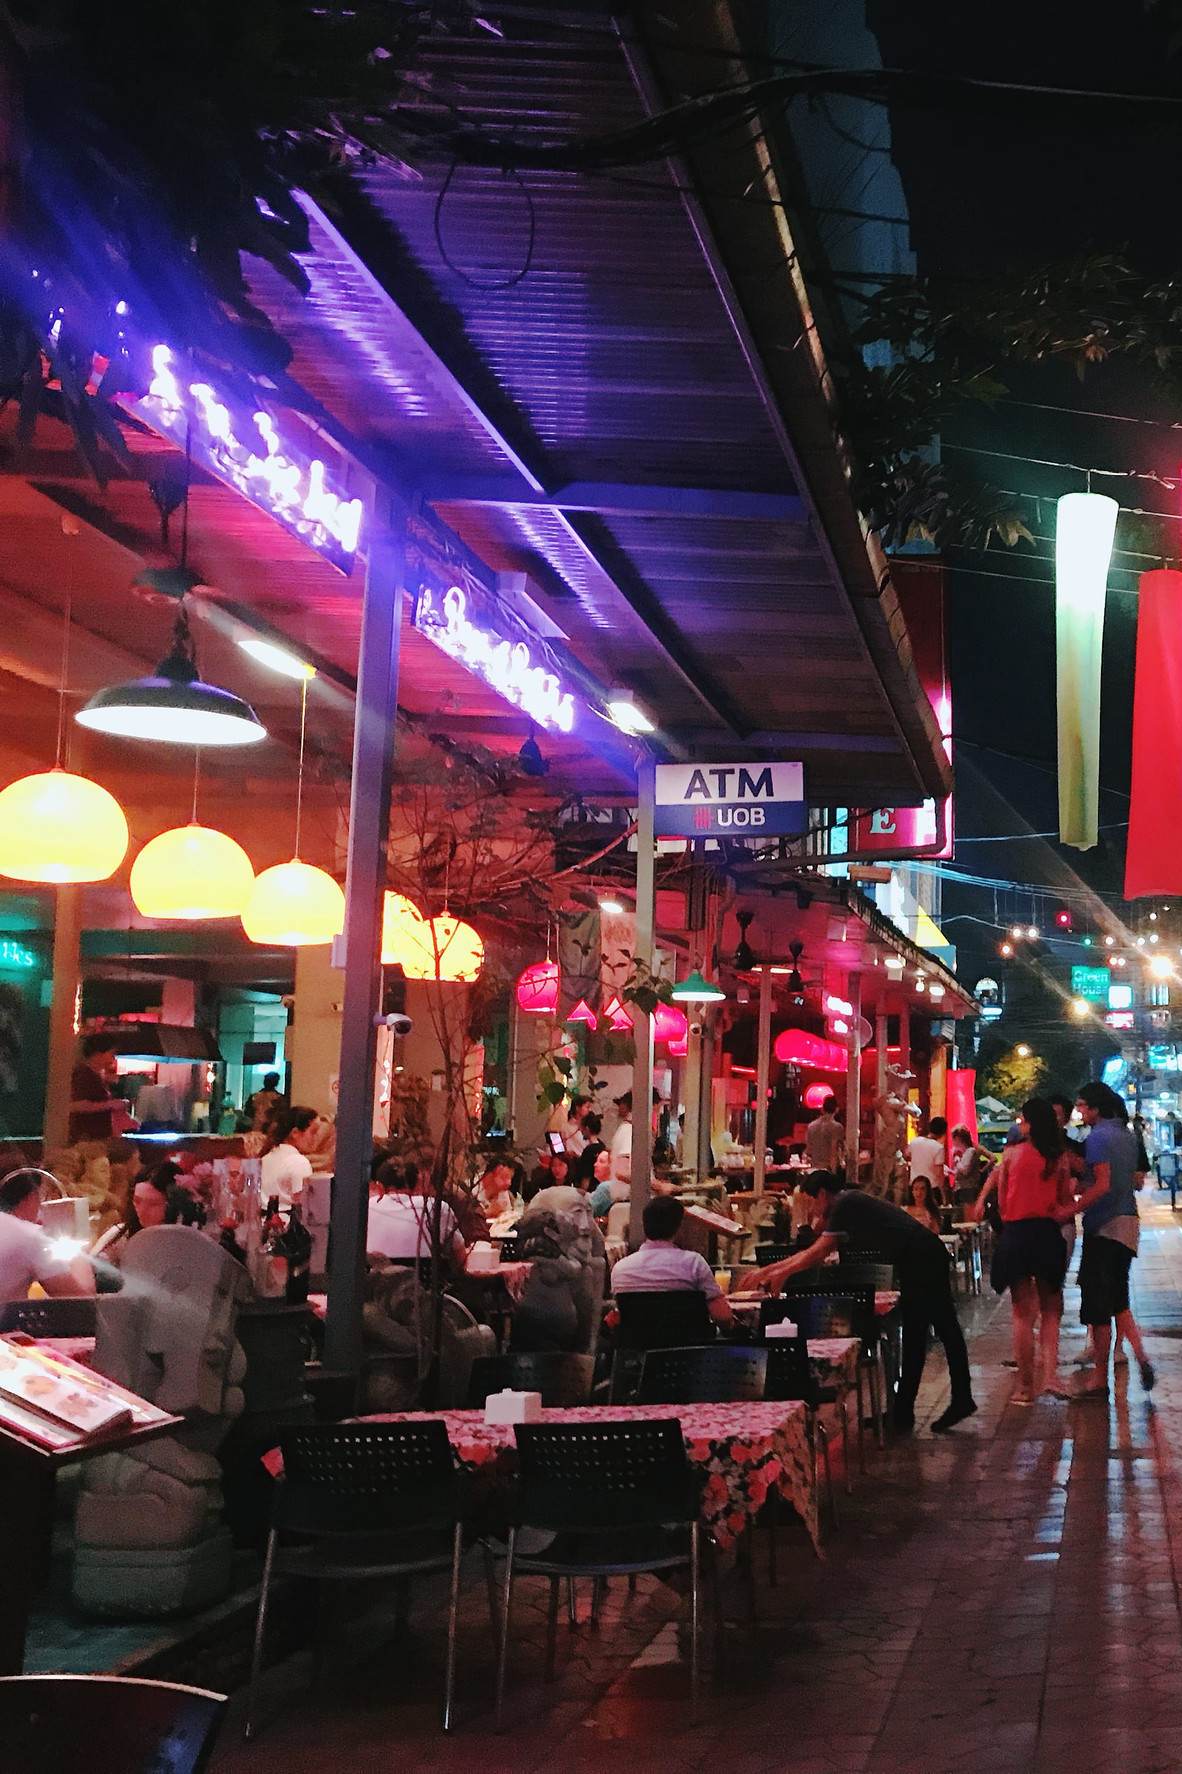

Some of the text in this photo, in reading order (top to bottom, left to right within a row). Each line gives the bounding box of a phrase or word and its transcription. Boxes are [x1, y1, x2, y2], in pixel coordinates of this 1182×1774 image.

[684, 767, 775, 799] ATM
[717, 807, 766, 826] UOB
[870, 808, 896, 834] E
[1074, 970, 1109, 982] Green
